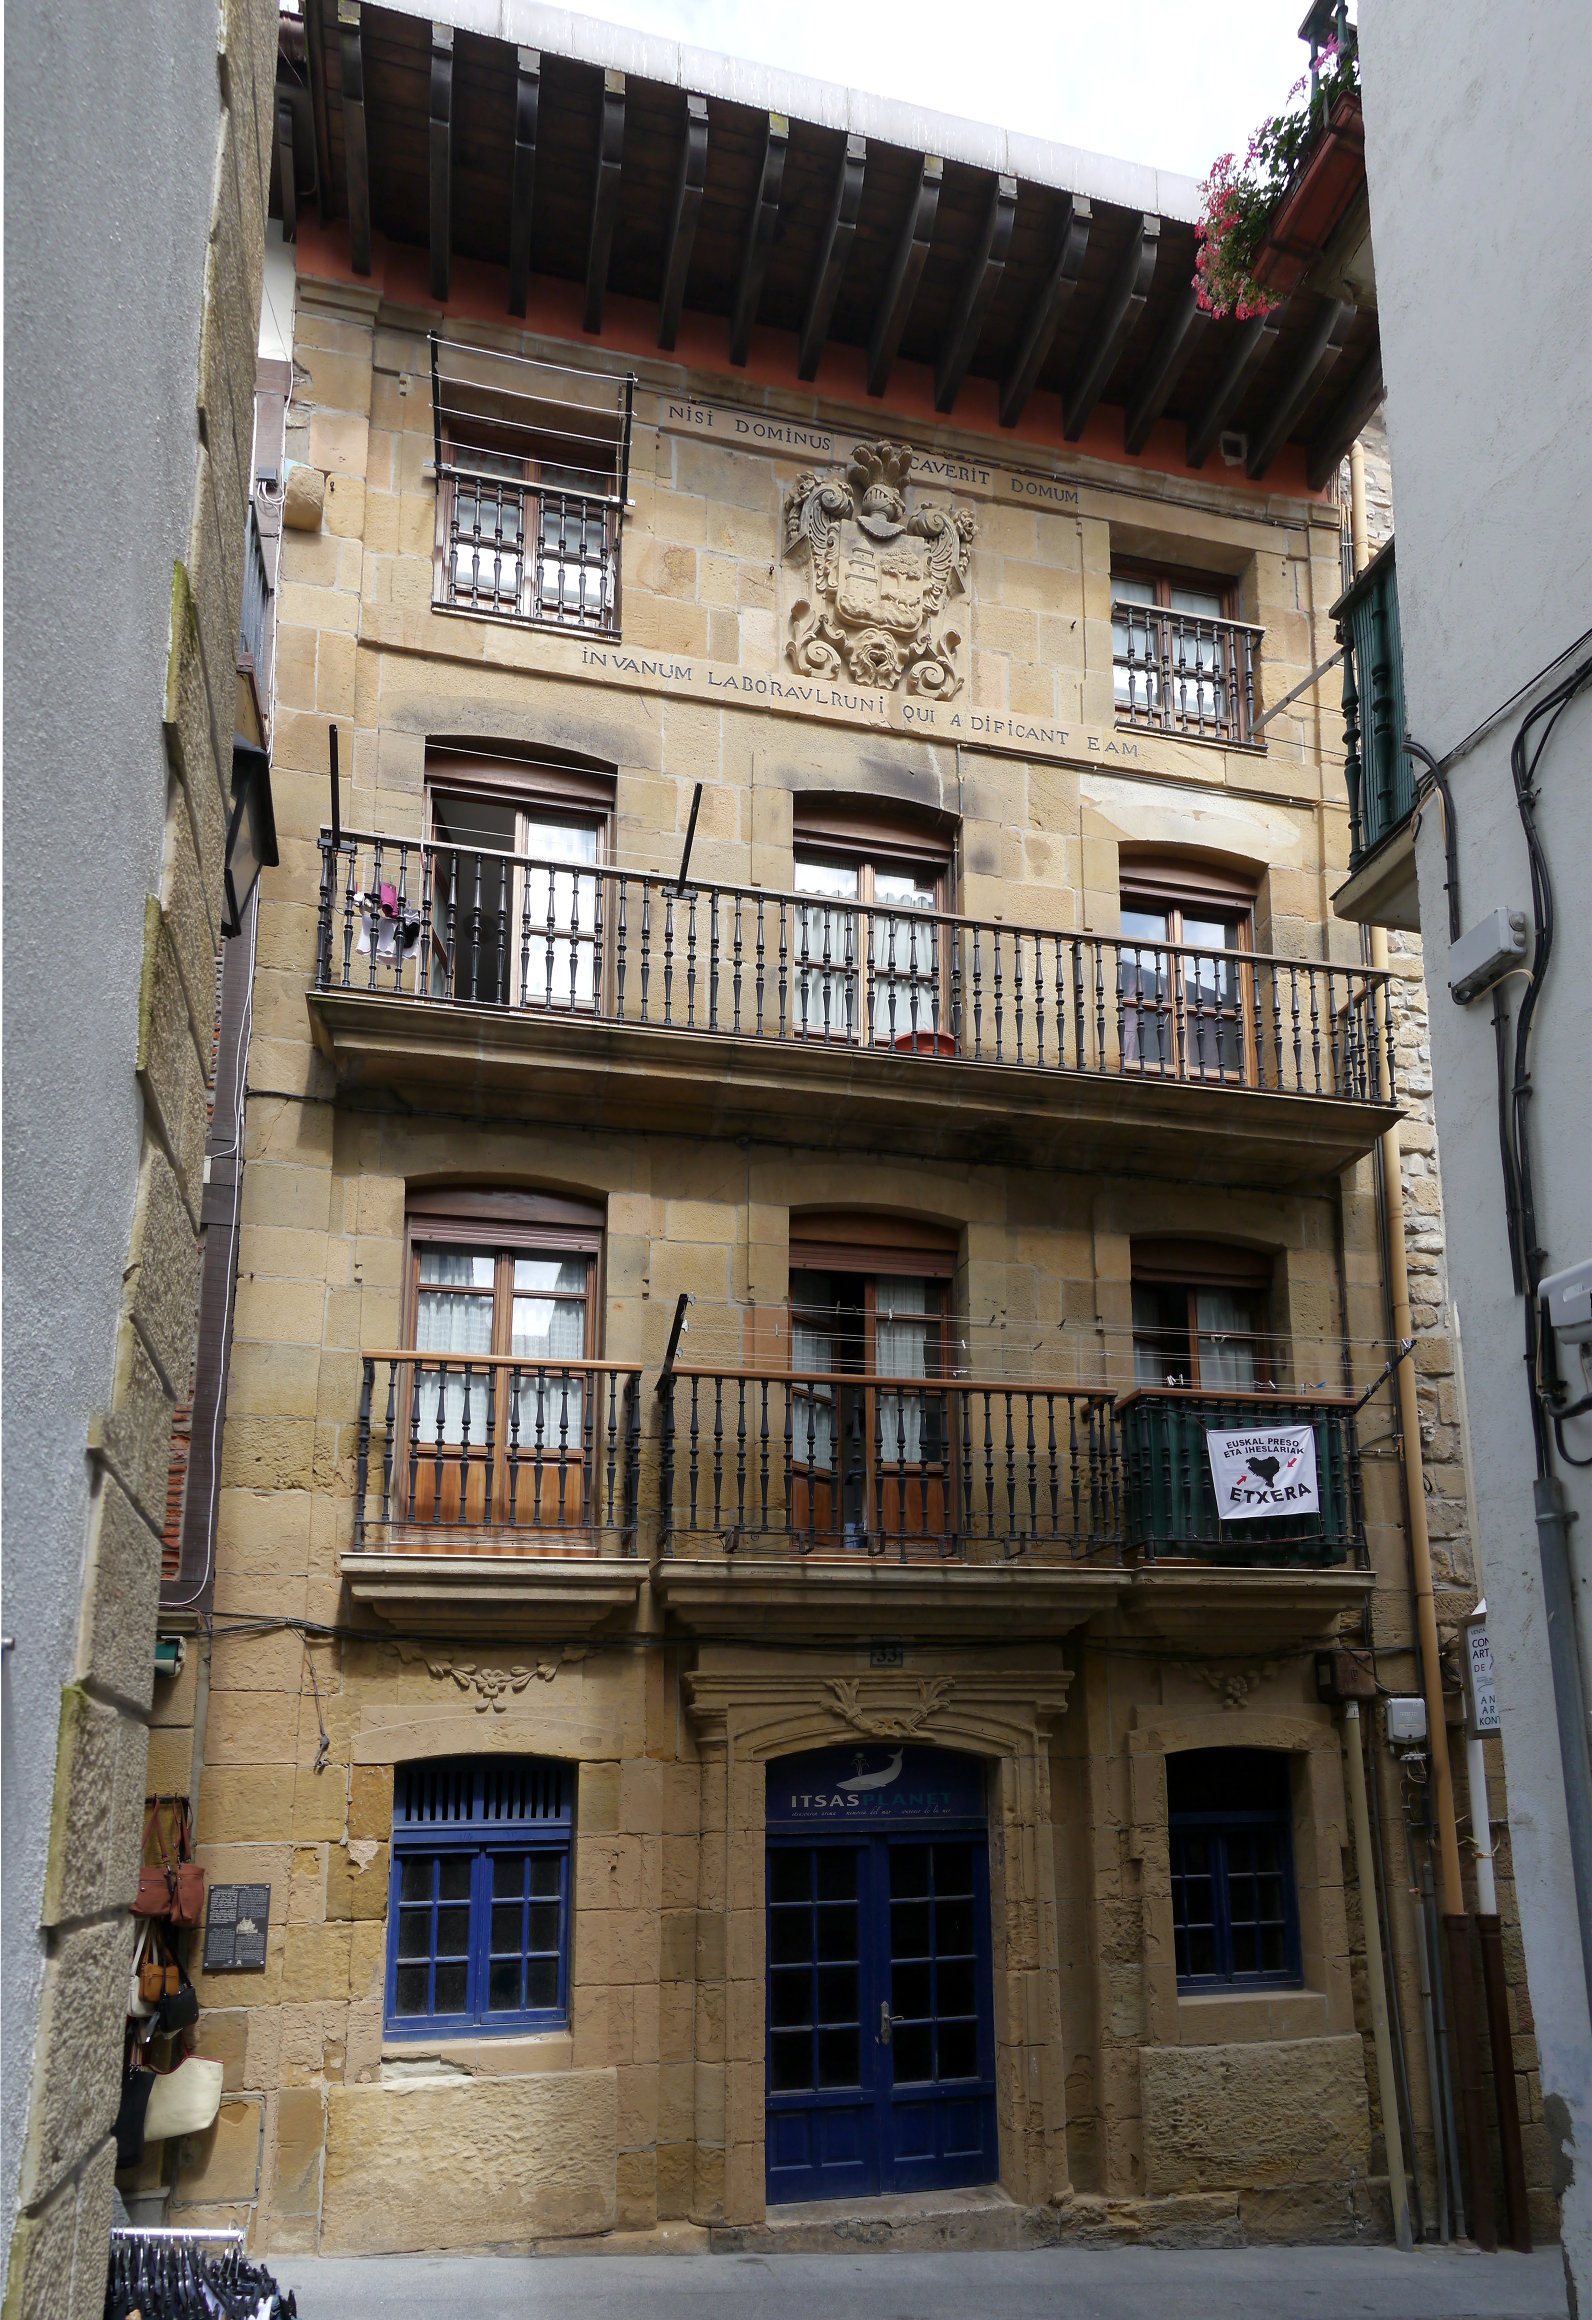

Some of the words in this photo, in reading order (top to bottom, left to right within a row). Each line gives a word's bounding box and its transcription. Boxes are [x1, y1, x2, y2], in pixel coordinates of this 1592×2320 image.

[735, 418, 831, 450] DOMINUS
[1011, 478, 1079, 504] DOMUM
[612, 655, 692, 681] VANUM
[902, 704, 935, 723] QUI
[1087, 736, 1139, 757] EAM
[1223, 1448, 1242, 1458] ETA
[1245, 1445, 1304, 1455] IHESLARIAK
[1226, 1437, 1264, 1449] EUSKAL
[1268, 1437, 1300, 1447] PRESO
[1230, 1482, 1312, 1505] ETXERA
[1473, 1663, 1486, 1673] DE
